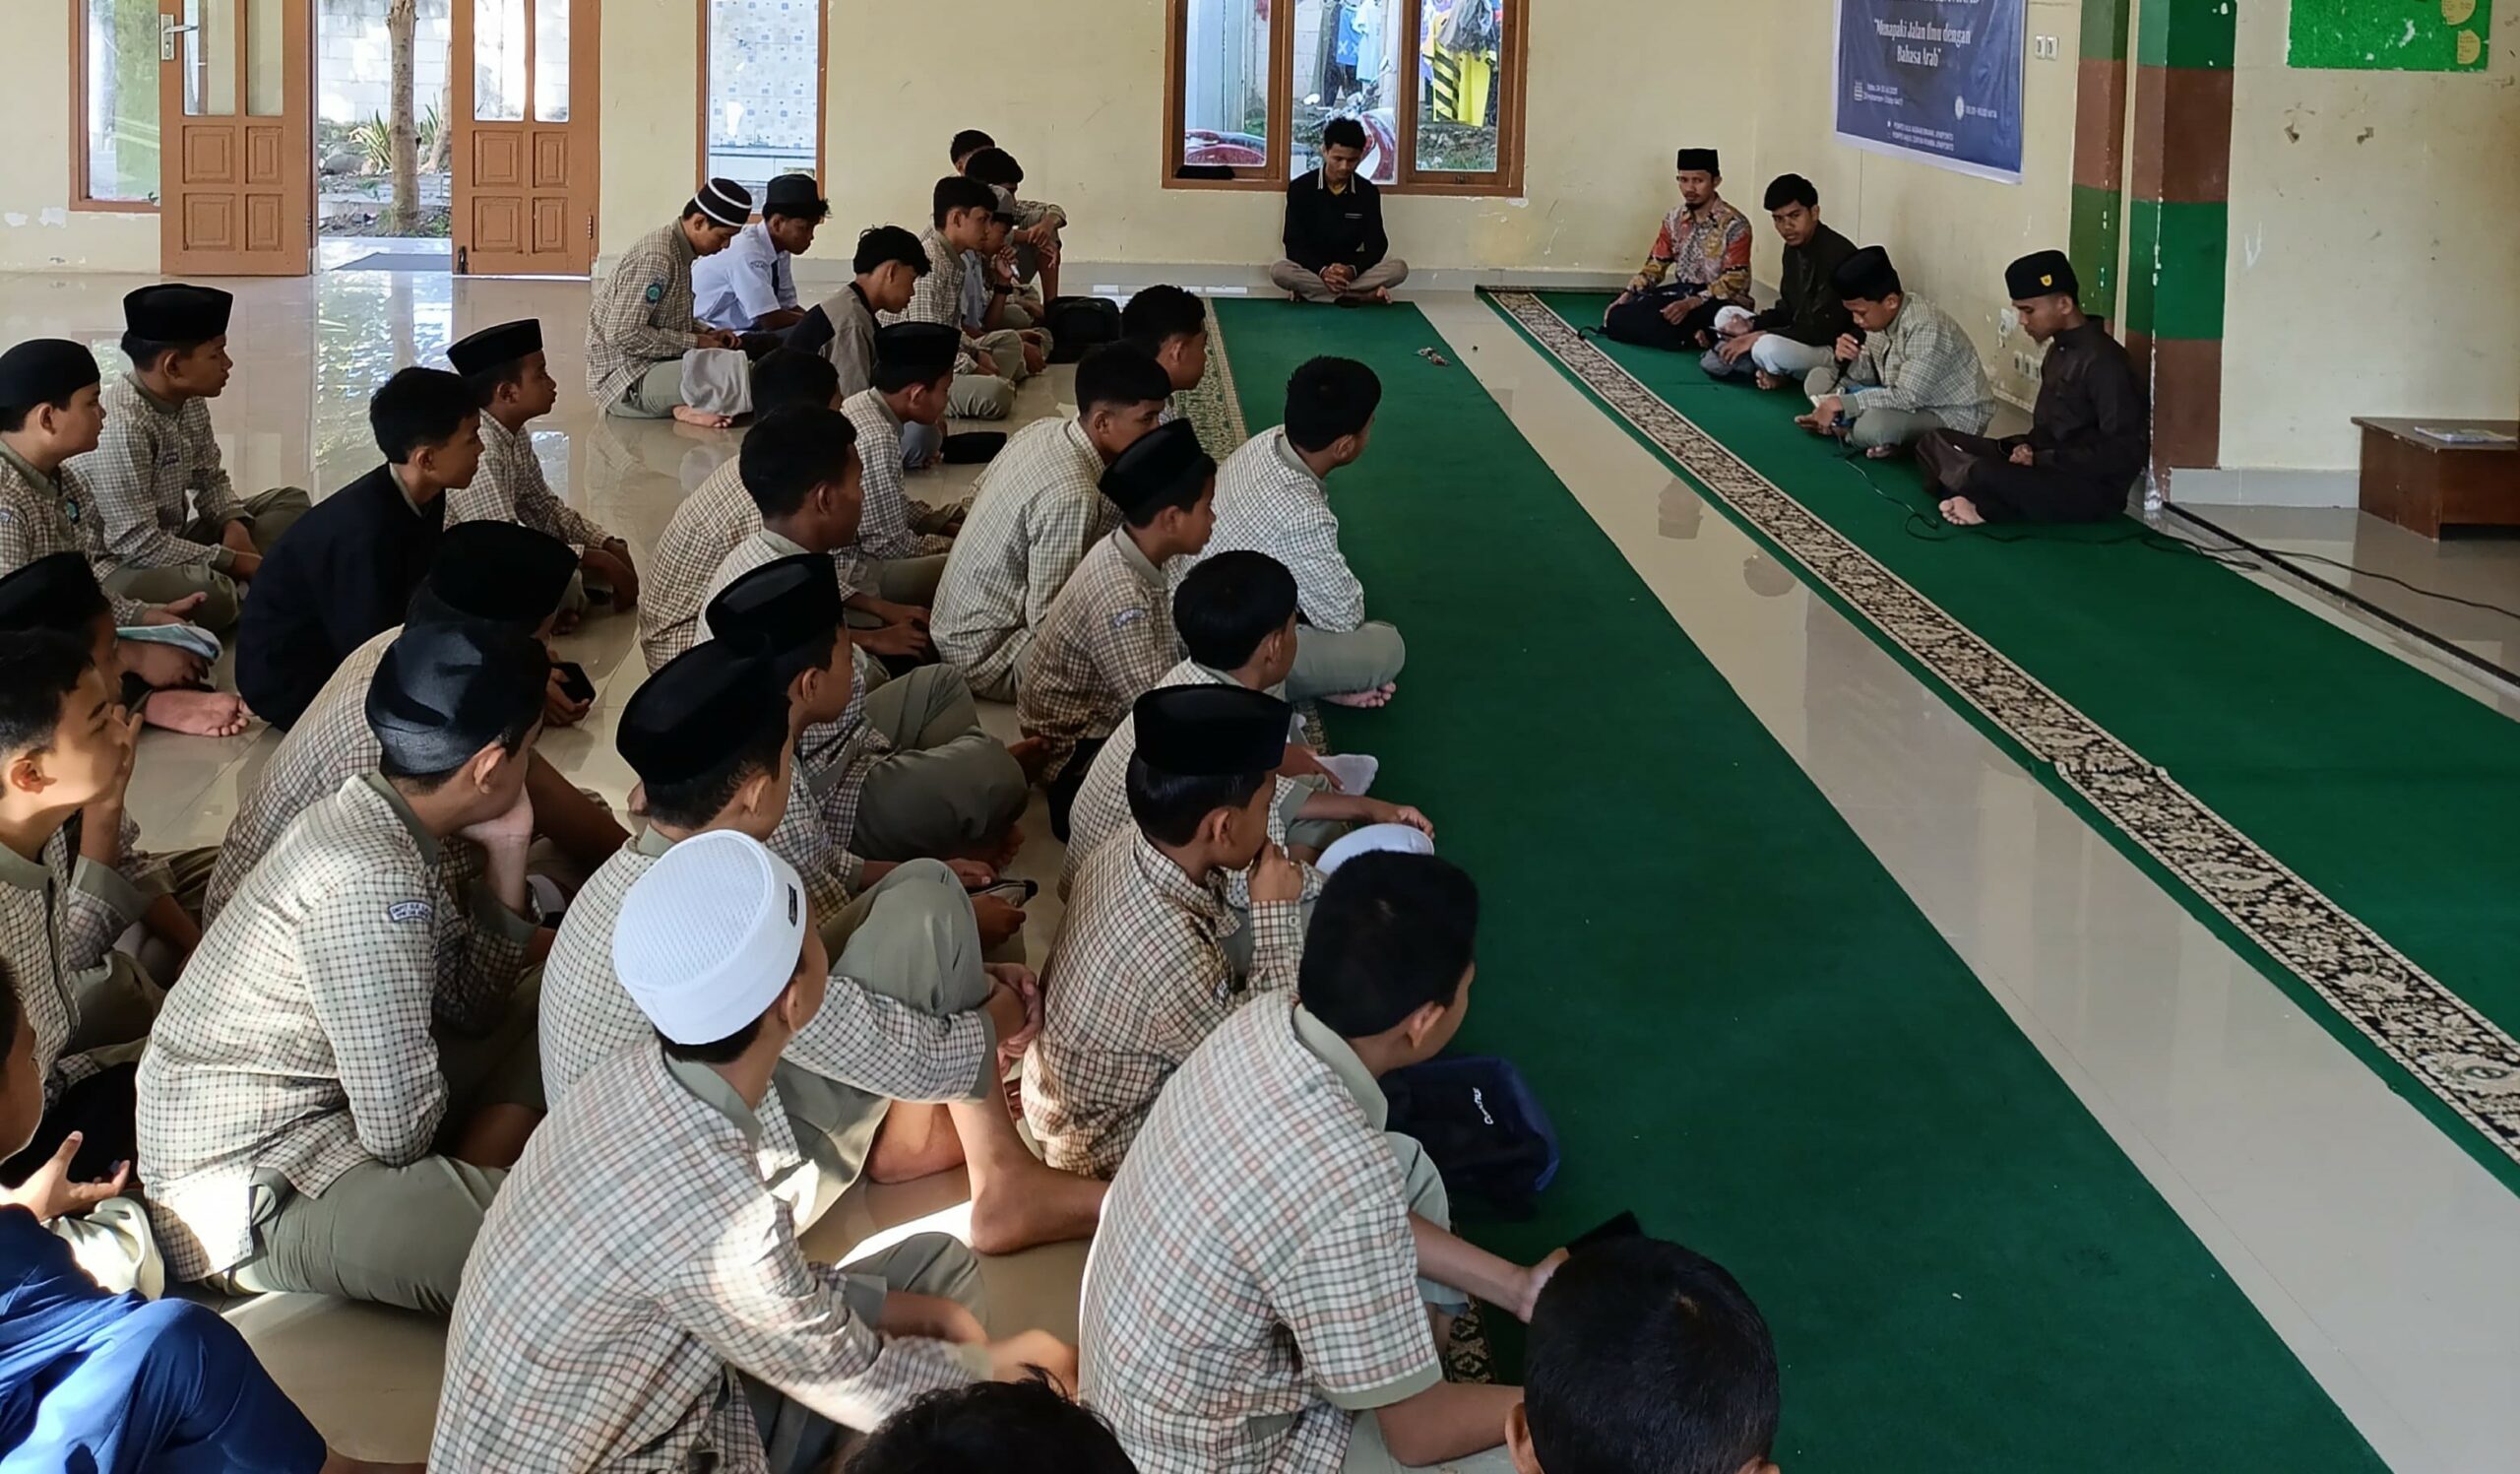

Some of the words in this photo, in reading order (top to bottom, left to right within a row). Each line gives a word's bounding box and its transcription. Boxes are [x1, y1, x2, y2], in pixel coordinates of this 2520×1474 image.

[1908, 21, 1925, 40] Jalan
[1943, 22, 1971, 48] dengan
[1897, 44, 1922, 65] Bahasa
